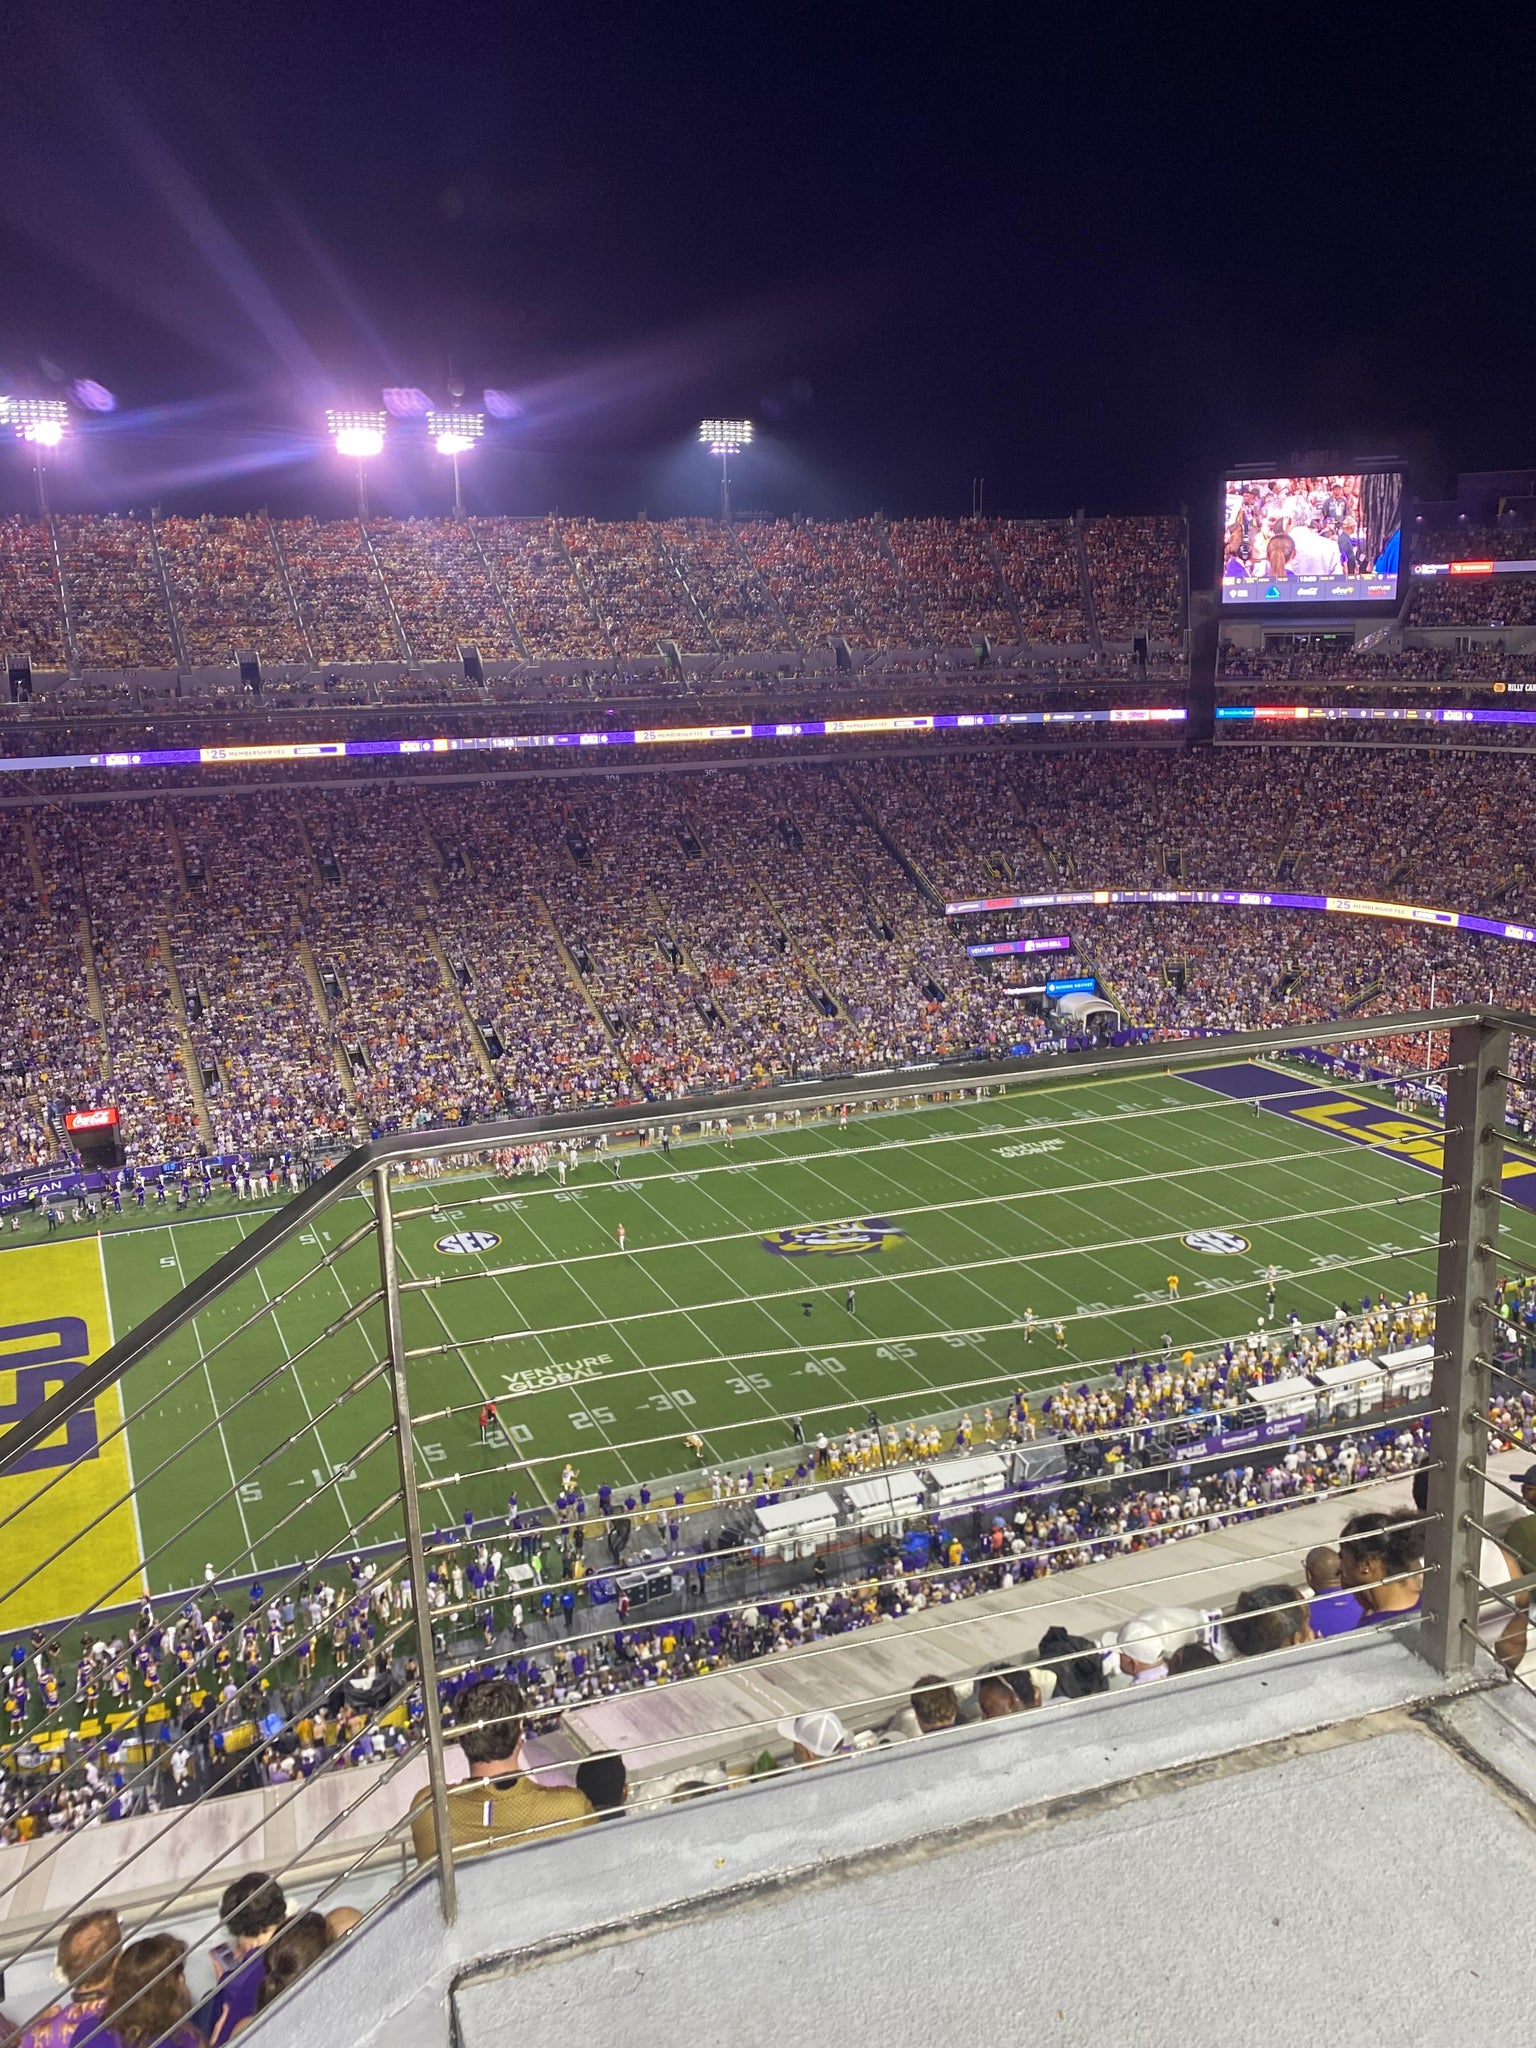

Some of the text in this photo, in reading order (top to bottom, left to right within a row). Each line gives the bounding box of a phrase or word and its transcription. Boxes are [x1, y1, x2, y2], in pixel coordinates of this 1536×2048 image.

[1507, 683, 1524, 691] BILLY
[971, 946, 994, 954] VENTURE
[72, 1111, 109, 1128] Coca-Cola
[991, 1138, 1066, 1154] VENTURE
[1001, 1145, 1063, 1158] GLOBAL
[1, 1181, 62, 1202] NISSAN
[436, 1231, 500, 1254] SEC
[1184, 1231, 1247, 1254] SEC
[876, 1342, 919, 1361] 45
[501, 1353, 614, 1384] VENTURE
[804, 1357, 848, 1377] 40
[508, 1366, 603, 1393] GLOBAL
[725, 1372, 773, 1395] 35
[648, 1388, 697, 1412] 30
[568, 1405, 618, 1431] 25
[239, 1481, 263, 1503] 5
